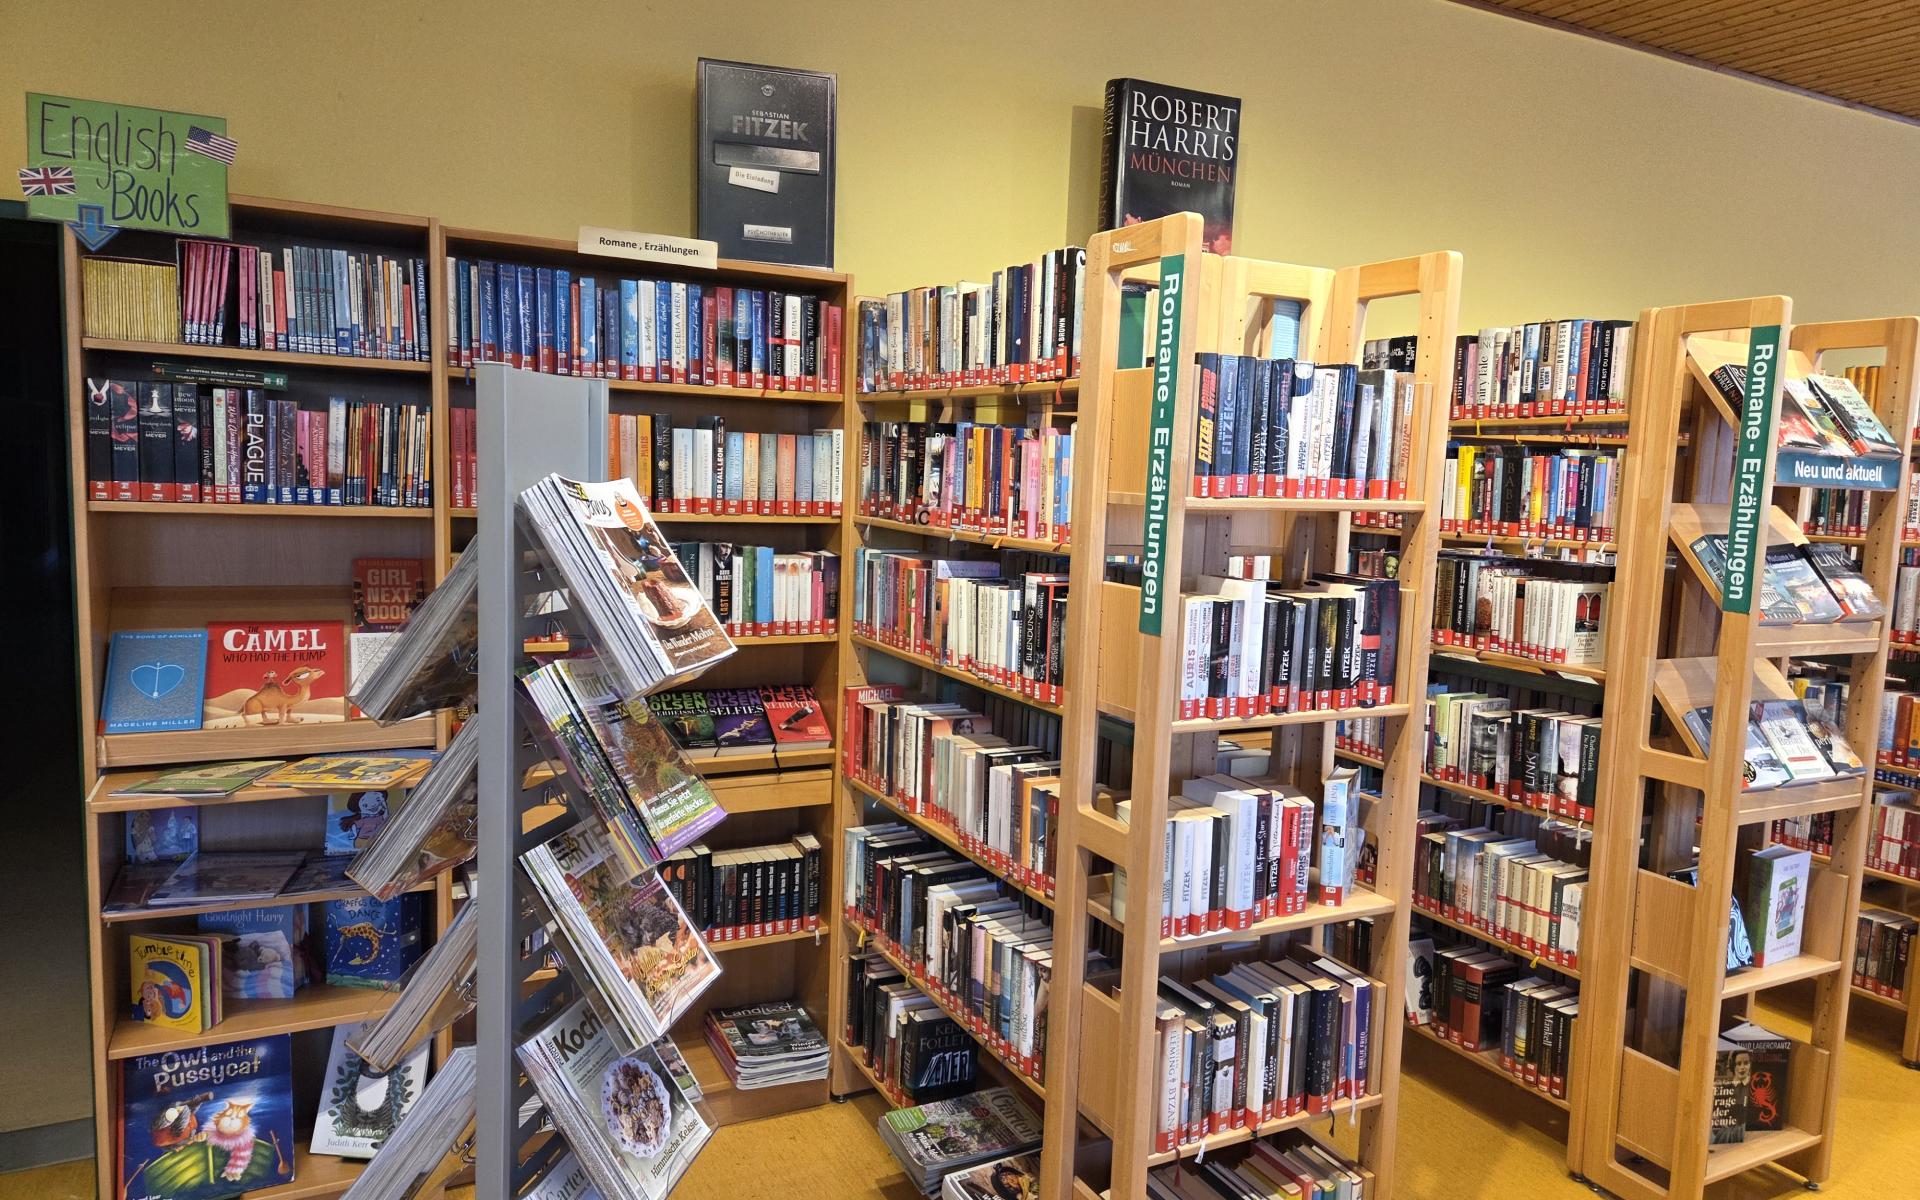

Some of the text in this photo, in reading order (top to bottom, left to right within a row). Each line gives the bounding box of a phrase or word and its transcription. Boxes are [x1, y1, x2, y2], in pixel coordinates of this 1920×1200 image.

[752, 110, 790, 120] SEBASTIAN
[1104, 86, 1115, 136] HARRIS
[1132, 91, 1236, 132] ROBERT
[732, 115, 809, 141] FITZEK
[1131, 120, 1234, 160] HARRIS
[41, 101, 176, 190] English
[746, 173, 774, 186] Einladung
[1131, 152, 1231, 183] MÜNCHEN
[112, 169, 200, 228] Books
[600, 236, 699, 256] Romane Erzählungen
[522, 291, 533, 347] Hundert Namen
[1058, 317, 1066, 341] BROWN
[1556, 324, 1567, 364] DRAUSSEN
[1602, 358, 1608, 367] DU
[1477, 356, 1489, 406] Fairy Tale
[662, 427, 670, 455] ZARIN
[1198, 417, 1208, 462] FITZEK
[1221, 404, 1236, 455] FITZEK
[247, 414, 264, 482] PLAGUE
[640, 436, 648, 458] PARIS
[1143, 272, 1180, 615] Romane Erzählungen
[1252, 432, 1261, 475] SEBASTIAN
[1271, 425, 1288, 473] NOAH
[1358, 433, 1368, 470] FITZEK
[203, 449, 212, 468] rivals
[1794, 460, 1882, 483] Neu und aktuell
[1728, 344, 1774, 600] Romane Erzählungen
[919, 510, 930, 524] C
[1814, 552, 1852, 567] LINK
[367, 568, 410, 586] GIRL
[367, 586, 412, 603] NEXT
[720, 581, 729, 615] LAST MILE
[367, 605, 412, 620] DOOR
[223, 628, 327, 652] CAMEL
[248, 625, 259, 634] THE
[670, 634, 693, 650] Wunder
[692, 628, 715, 642] Mohn
[1025, 610, 1034, 662] BLENDUNG
[223, 650, 326, 664] WHO HAD THE HUMP
[1187, 649, 1195, 688] AURIS
[1281, 650, 1290, 681] FITZEK
[1323, 646, 1332, 677] FITZEK
[1342, 646, 1351, 678] FITZEK
[650, 692, 704, 702] ADLER
[653, 701, 707, 710] OLSEN
[859, 688, 894, 700] MICHAEL
[709, 705, 764, 716] SELFIES
[110, 720, 159, 728] MADELINE
[1525, 719, 1537, 786] LINK Schuld
[1587, 735, 1597, 771] Charlotte Link
[676, 790, 692, 805] jetzt
[685, 799, 704, 815] Hecke
[1258, 820, 1266, 839] Stars
[1257, 844, 1266, 860] Free
[1243, 863, 1251, 899] FITZEK
[1297, 855, 1306, 885] AURIS
[204, 910, 284, 927] Goodnight Harry
[347, 907, 382, 920] DANCE
[552, 1008, 602, 1062] Koch
[936, 1025, 960, 1036] KEN
[1543, 1013, 1554, 1046] Mankell
[136, 1057, 159, 1071] The
[160, 1047, 208, 1073] Owl
[1168, 1030, 1178, 1075] FLEMING
[153, 1057, 261, 1093] Pussycat
[1713, 1086, 1734, 1096] Eine
[1715, 1097, 1736, 1108] rage
[991, 1094, 1037, 1139] Garten
[1712, 1108, 1729, 1116] der
[326, 1138, 370, 1149] Judith Kerr
[650, 1118, 699, 1180] Himmlische Kekse
